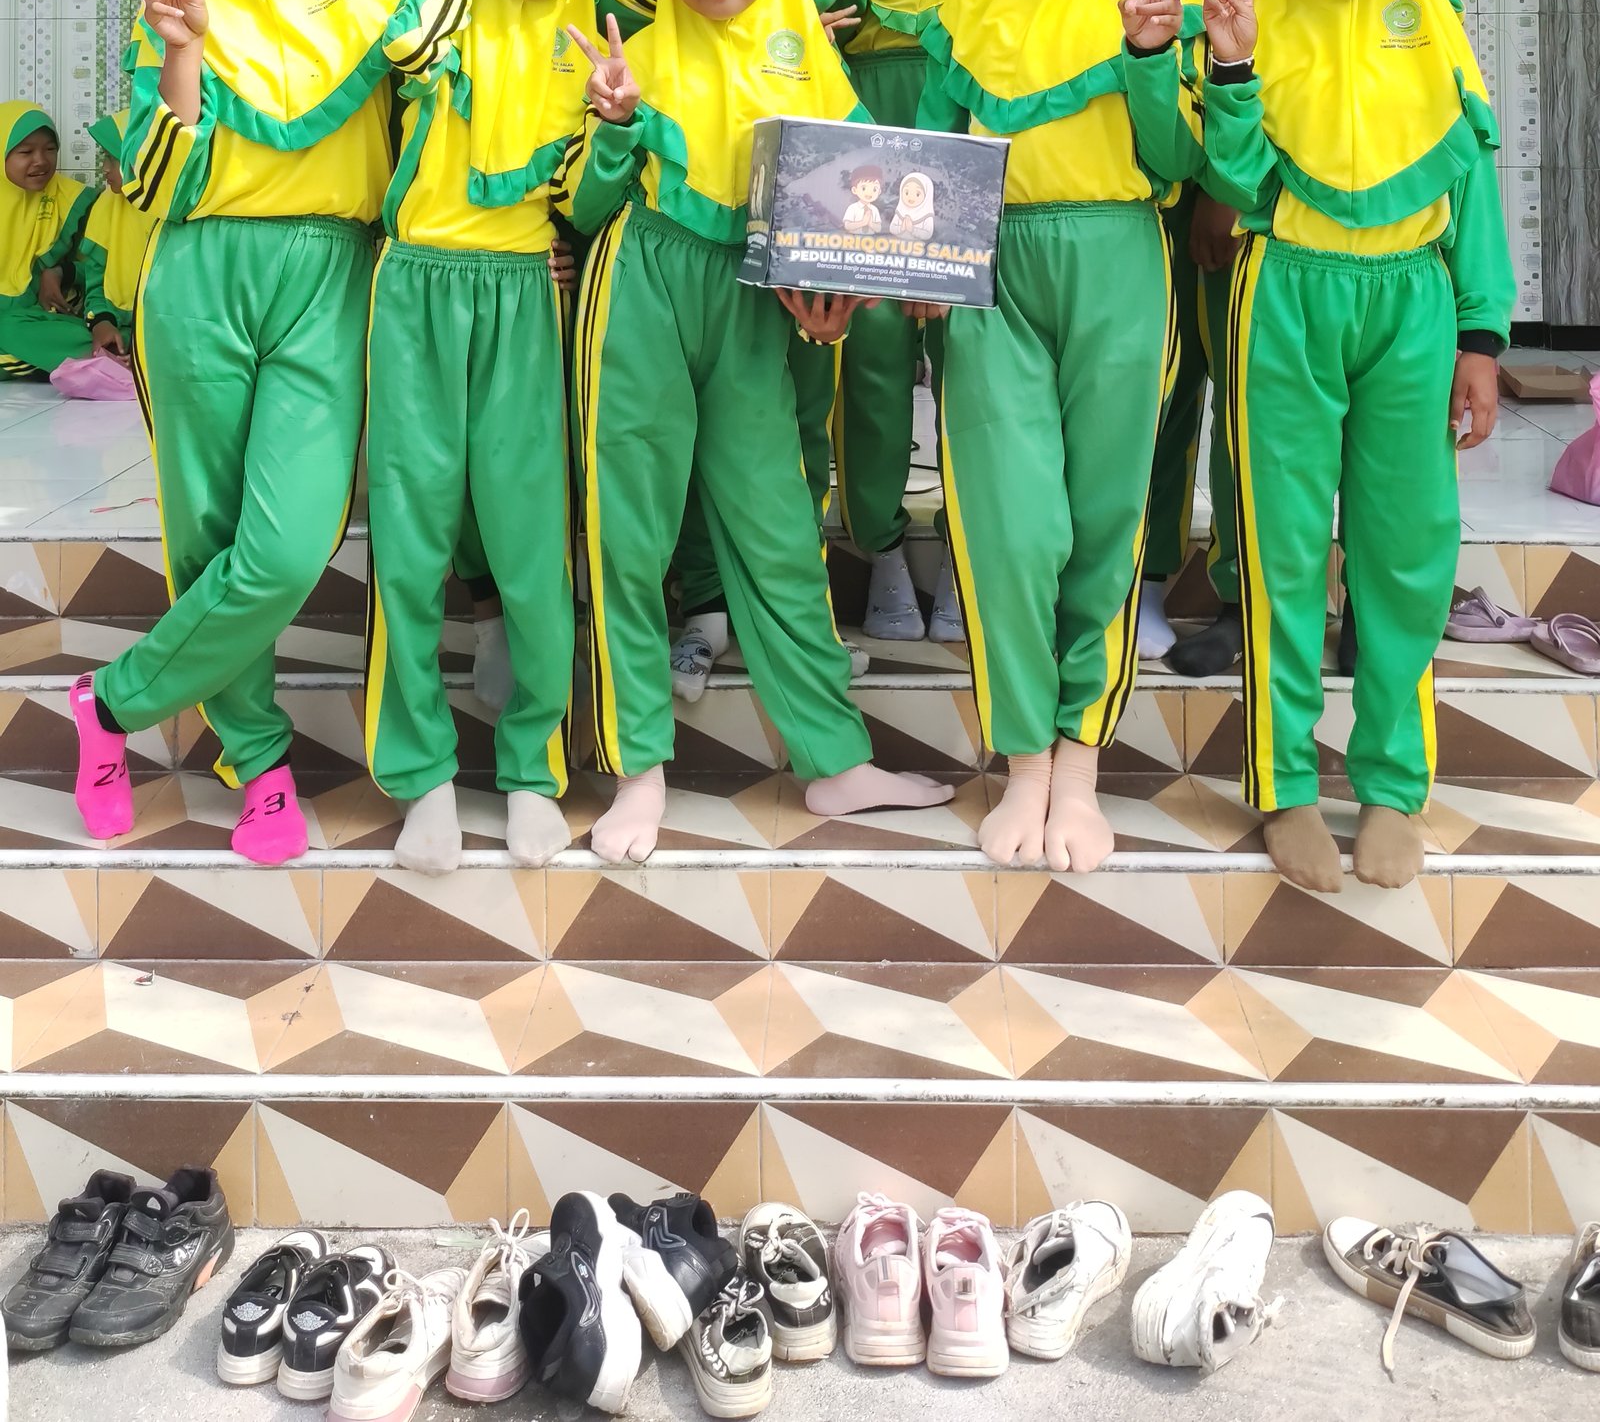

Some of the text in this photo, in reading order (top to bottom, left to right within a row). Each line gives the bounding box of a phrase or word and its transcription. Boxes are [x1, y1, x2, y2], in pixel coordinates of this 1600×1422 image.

[775, 231, 993, 266] MI THORIQOTUS SALAM
[789, 249, 976, 279] PEDULI KORBAN BENCANA
[867, 274, 892, 282] Sumatra
[905, 270, 930, 278] Sumatra
